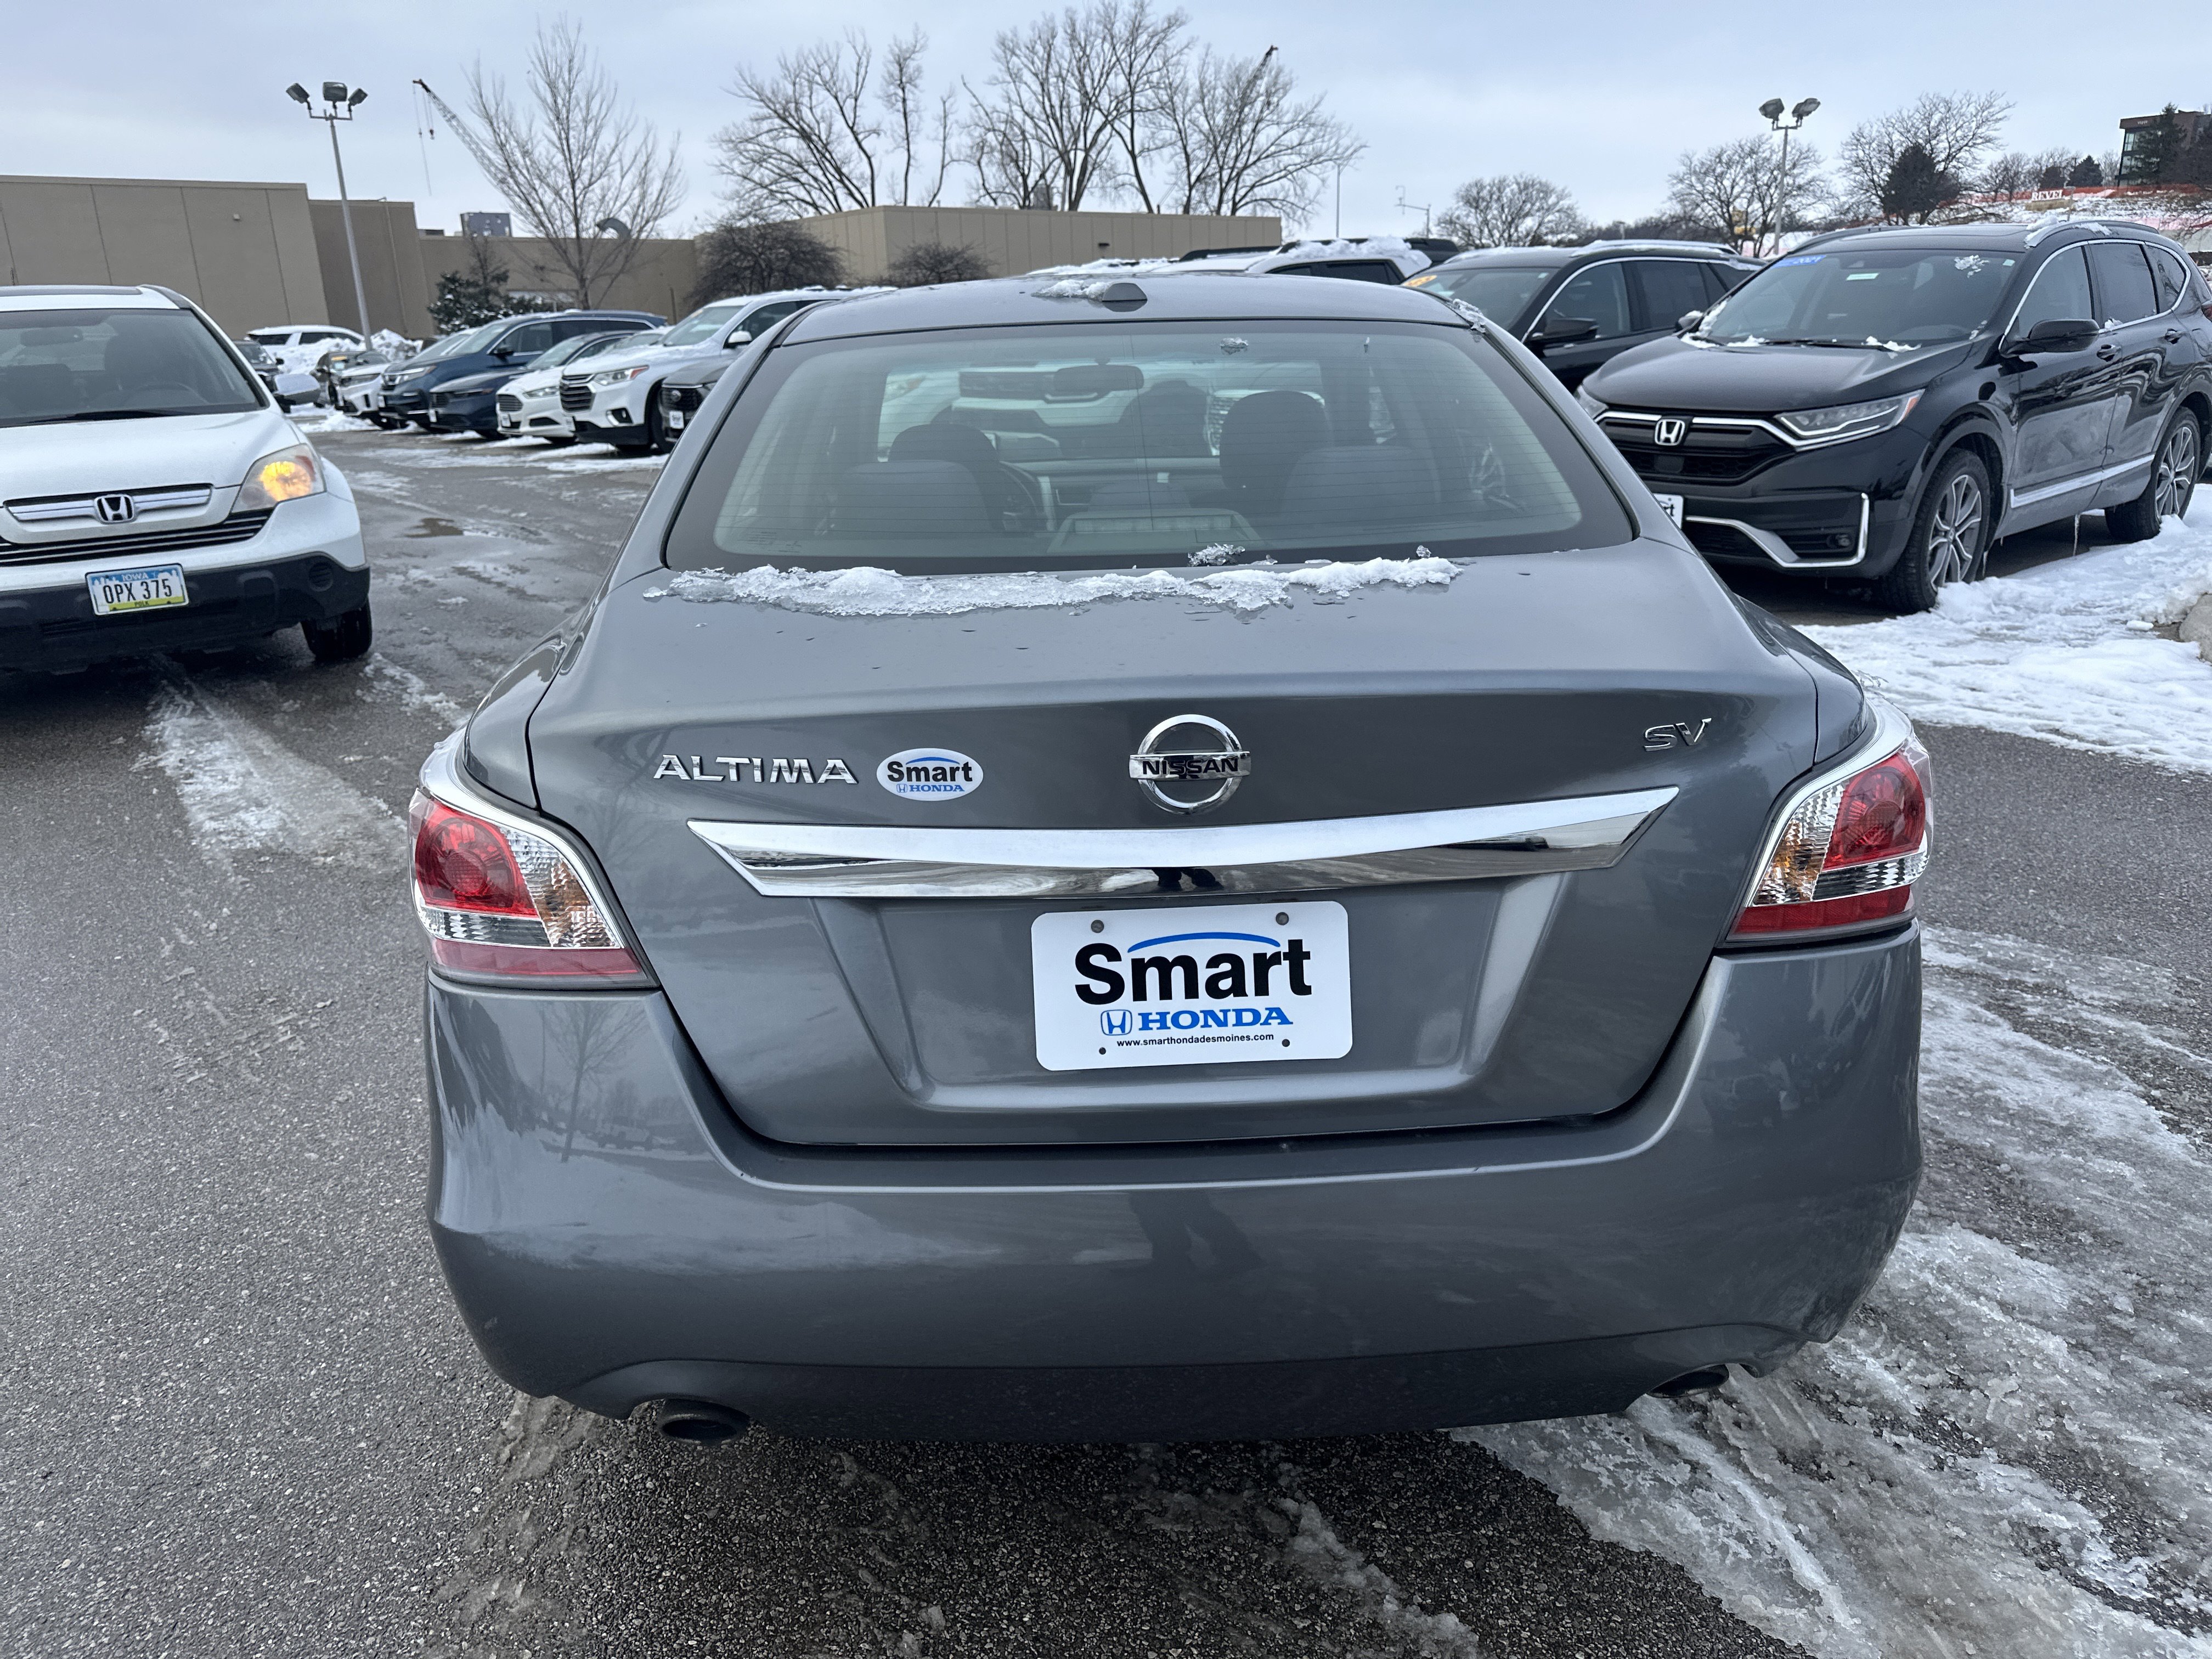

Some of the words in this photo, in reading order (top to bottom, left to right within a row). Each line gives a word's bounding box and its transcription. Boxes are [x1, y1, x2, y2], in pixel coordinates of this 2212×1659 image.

[122, 572, 149, 582] IOWA
[103, 582, 136, 603] OPX
[140, 578, 172, 599] 375
[1644, 718, 1712, 752] SV
[653, 754, 859, 784] ALTIMA
[887, 761, 973, 782] Smart
[1142, 757, 1239, 775] NISSAN
[1074, 939, 1312, 1005] Smart
[1137, 1007, 1294, 1031] HONDA
[1116, 1032, 1274, 1047] www.smarthondadesmoines.com
